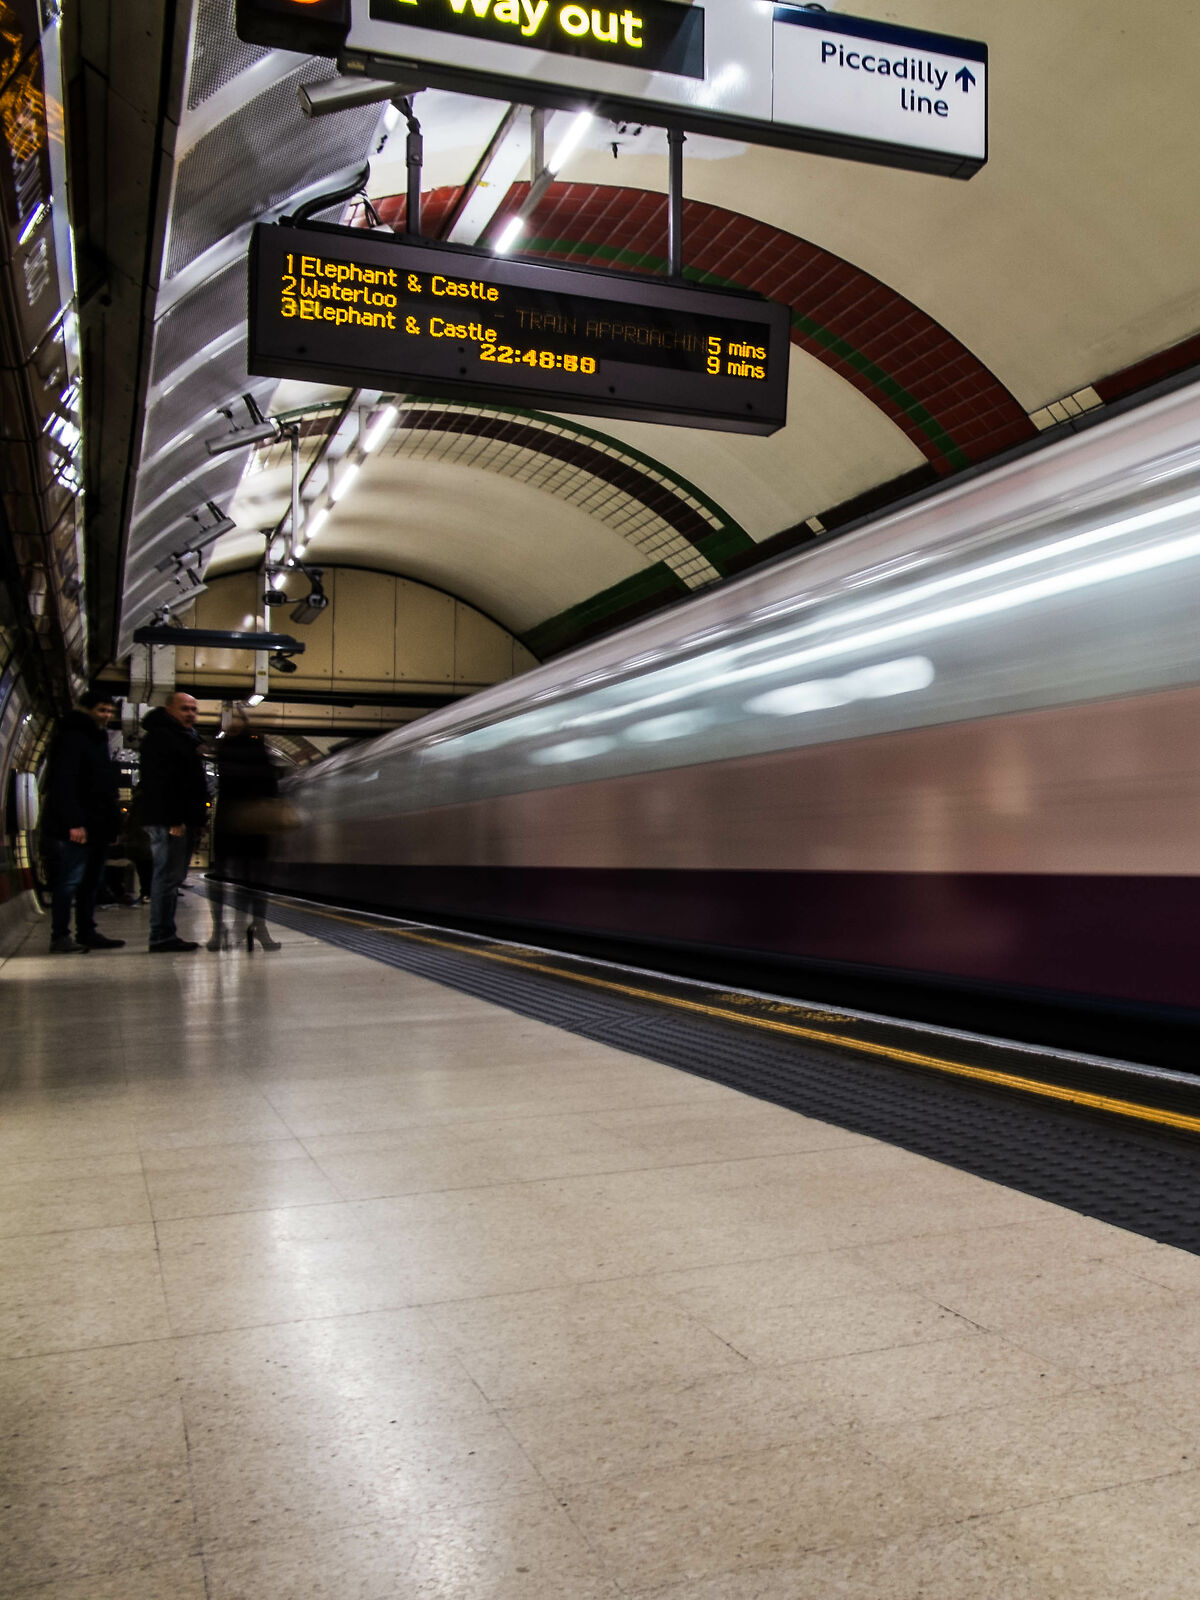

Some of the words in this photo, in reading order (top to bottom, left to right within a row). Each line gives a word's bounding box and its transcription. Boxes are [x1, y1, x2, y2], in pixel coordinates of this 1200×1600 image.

[559, 4, 643, 48] out
[821, 41, 948, 90] Piccadilly
[901, 88, 949, 117] line
[287, 253, 294, 274] 1
[301, 255, 397, 287] Elephant
[407, 273, 422, 293] &
[431, 275, 499, 302] Castle
[281, 275, 297, 296] 2
[300, 278, 398, 308] Waterloo
[708, 336, 721, 355] 5
[728, 341, 766, 360] mins
[281, 297, 296, 317] 3
[299, 299, 396, 330] Elephant
[405, 316, 420, 335] &
[429, 317, 497, 343] Castle
[707, 355, 720, 375] 9
[727, 360, 766, 379] mins
[515, 308, 577, 335] TRAIN
